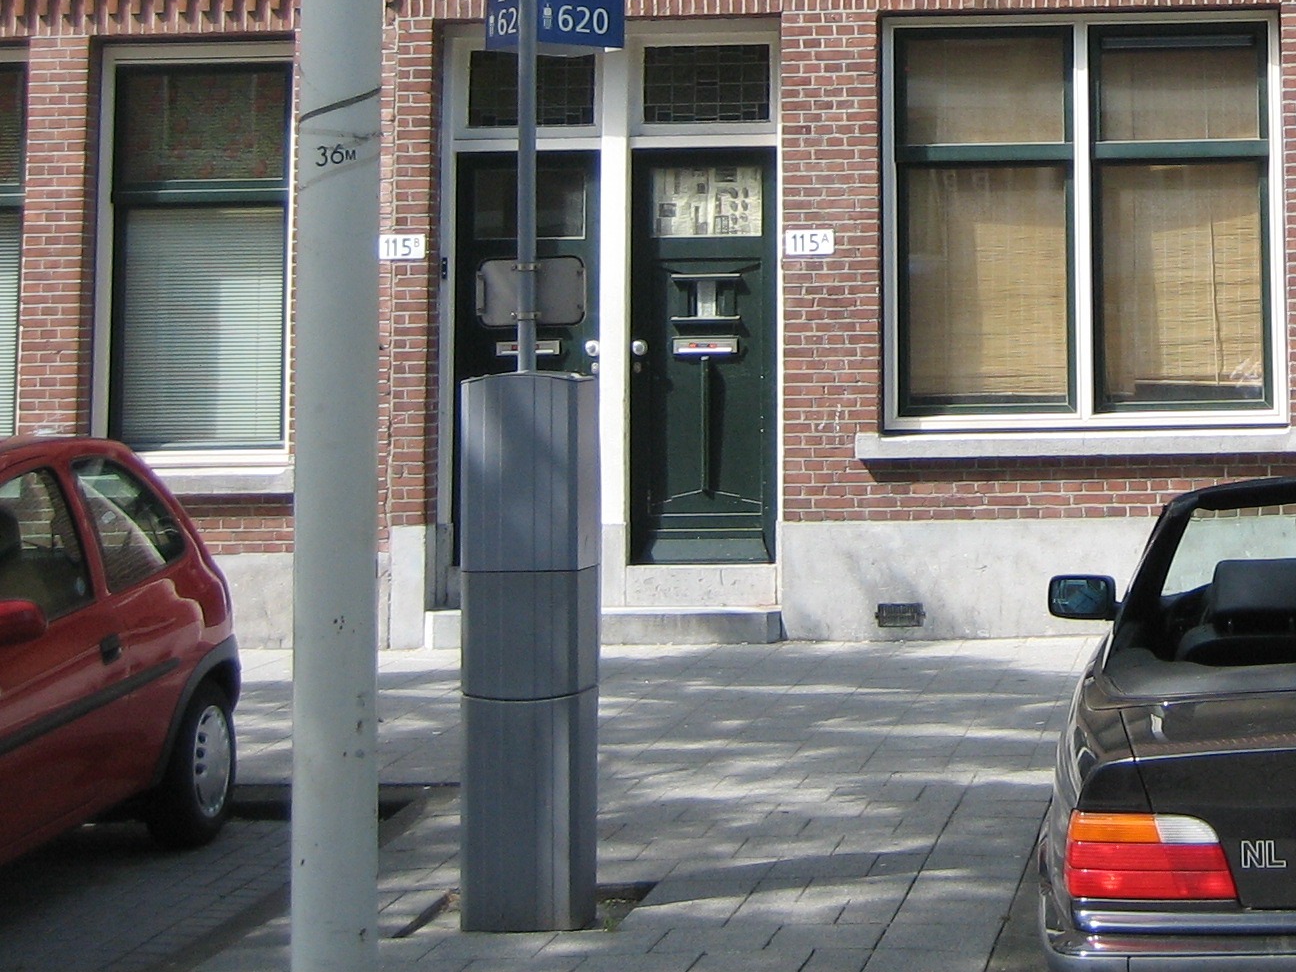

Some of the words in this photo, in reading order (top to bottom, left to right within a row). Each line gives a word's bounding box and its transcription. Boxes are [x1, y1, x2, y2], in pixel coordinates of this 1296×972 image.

[497, 7, 519, 36] 62
[558, 5, 609, 35] 620
[1240, 840, 1287, 869] NL
